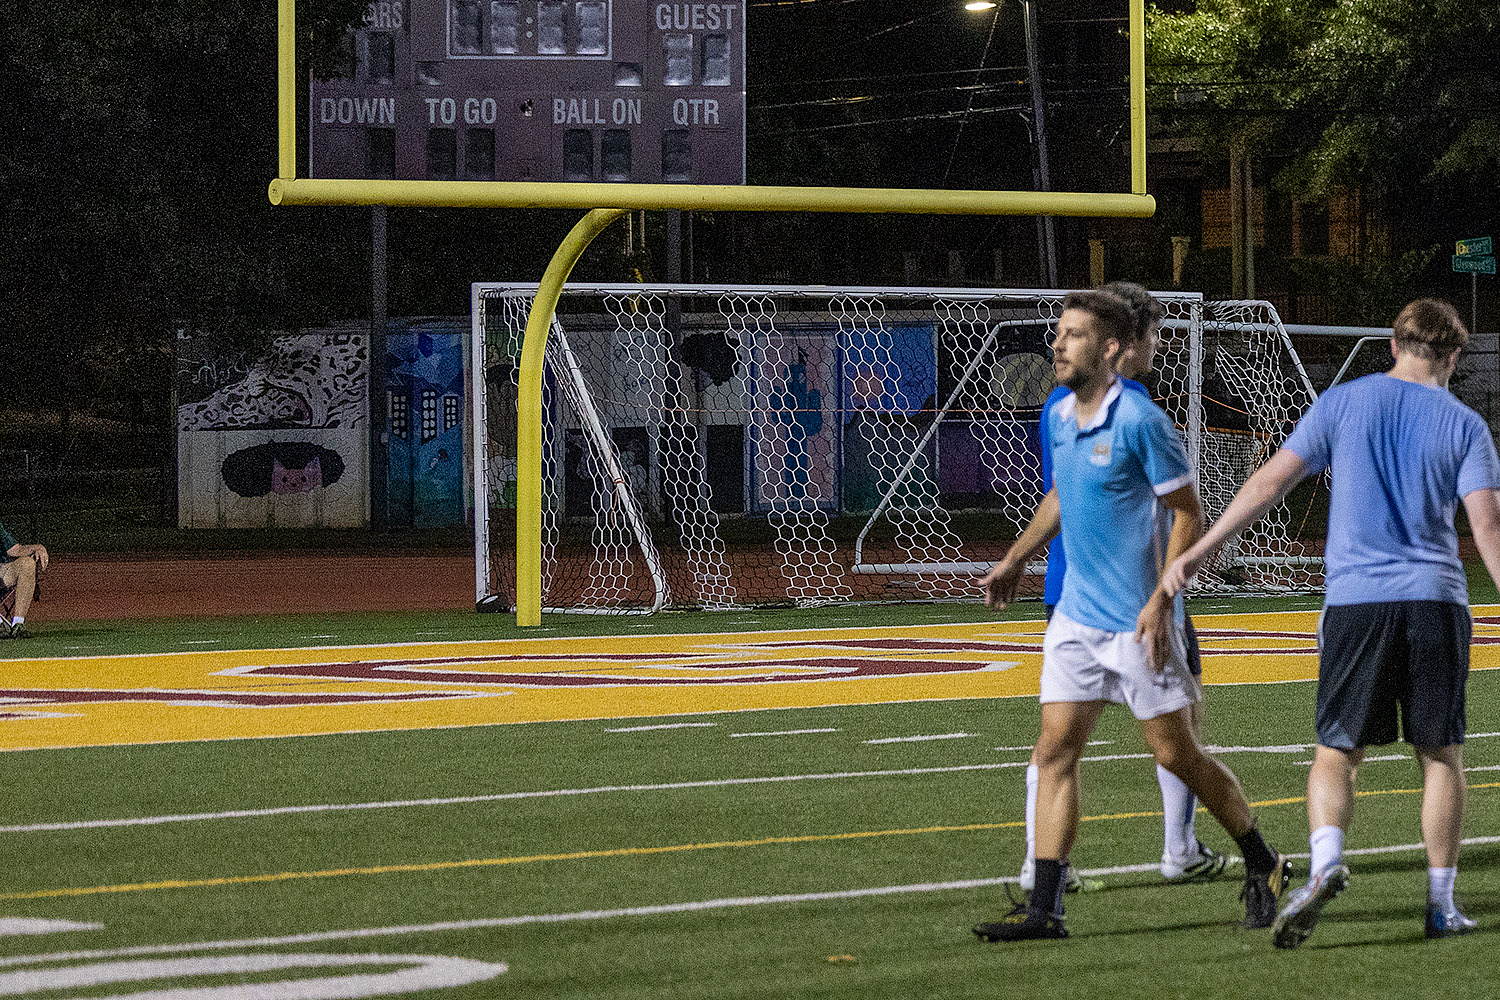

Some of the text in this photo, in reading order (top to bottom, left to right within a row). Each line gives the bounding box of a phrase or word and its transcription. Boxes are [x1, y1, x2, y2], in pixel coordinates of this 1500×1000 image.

[362, 1, 402, 29] ARS
[656, 3, 737, 30] GUEST
[321, 98, 395, 124] DOWN
[425, 97, 497, 124] TO GO
[553, 98, 642, 125] BALL ON
[673, 98, 720, 126] QTR
